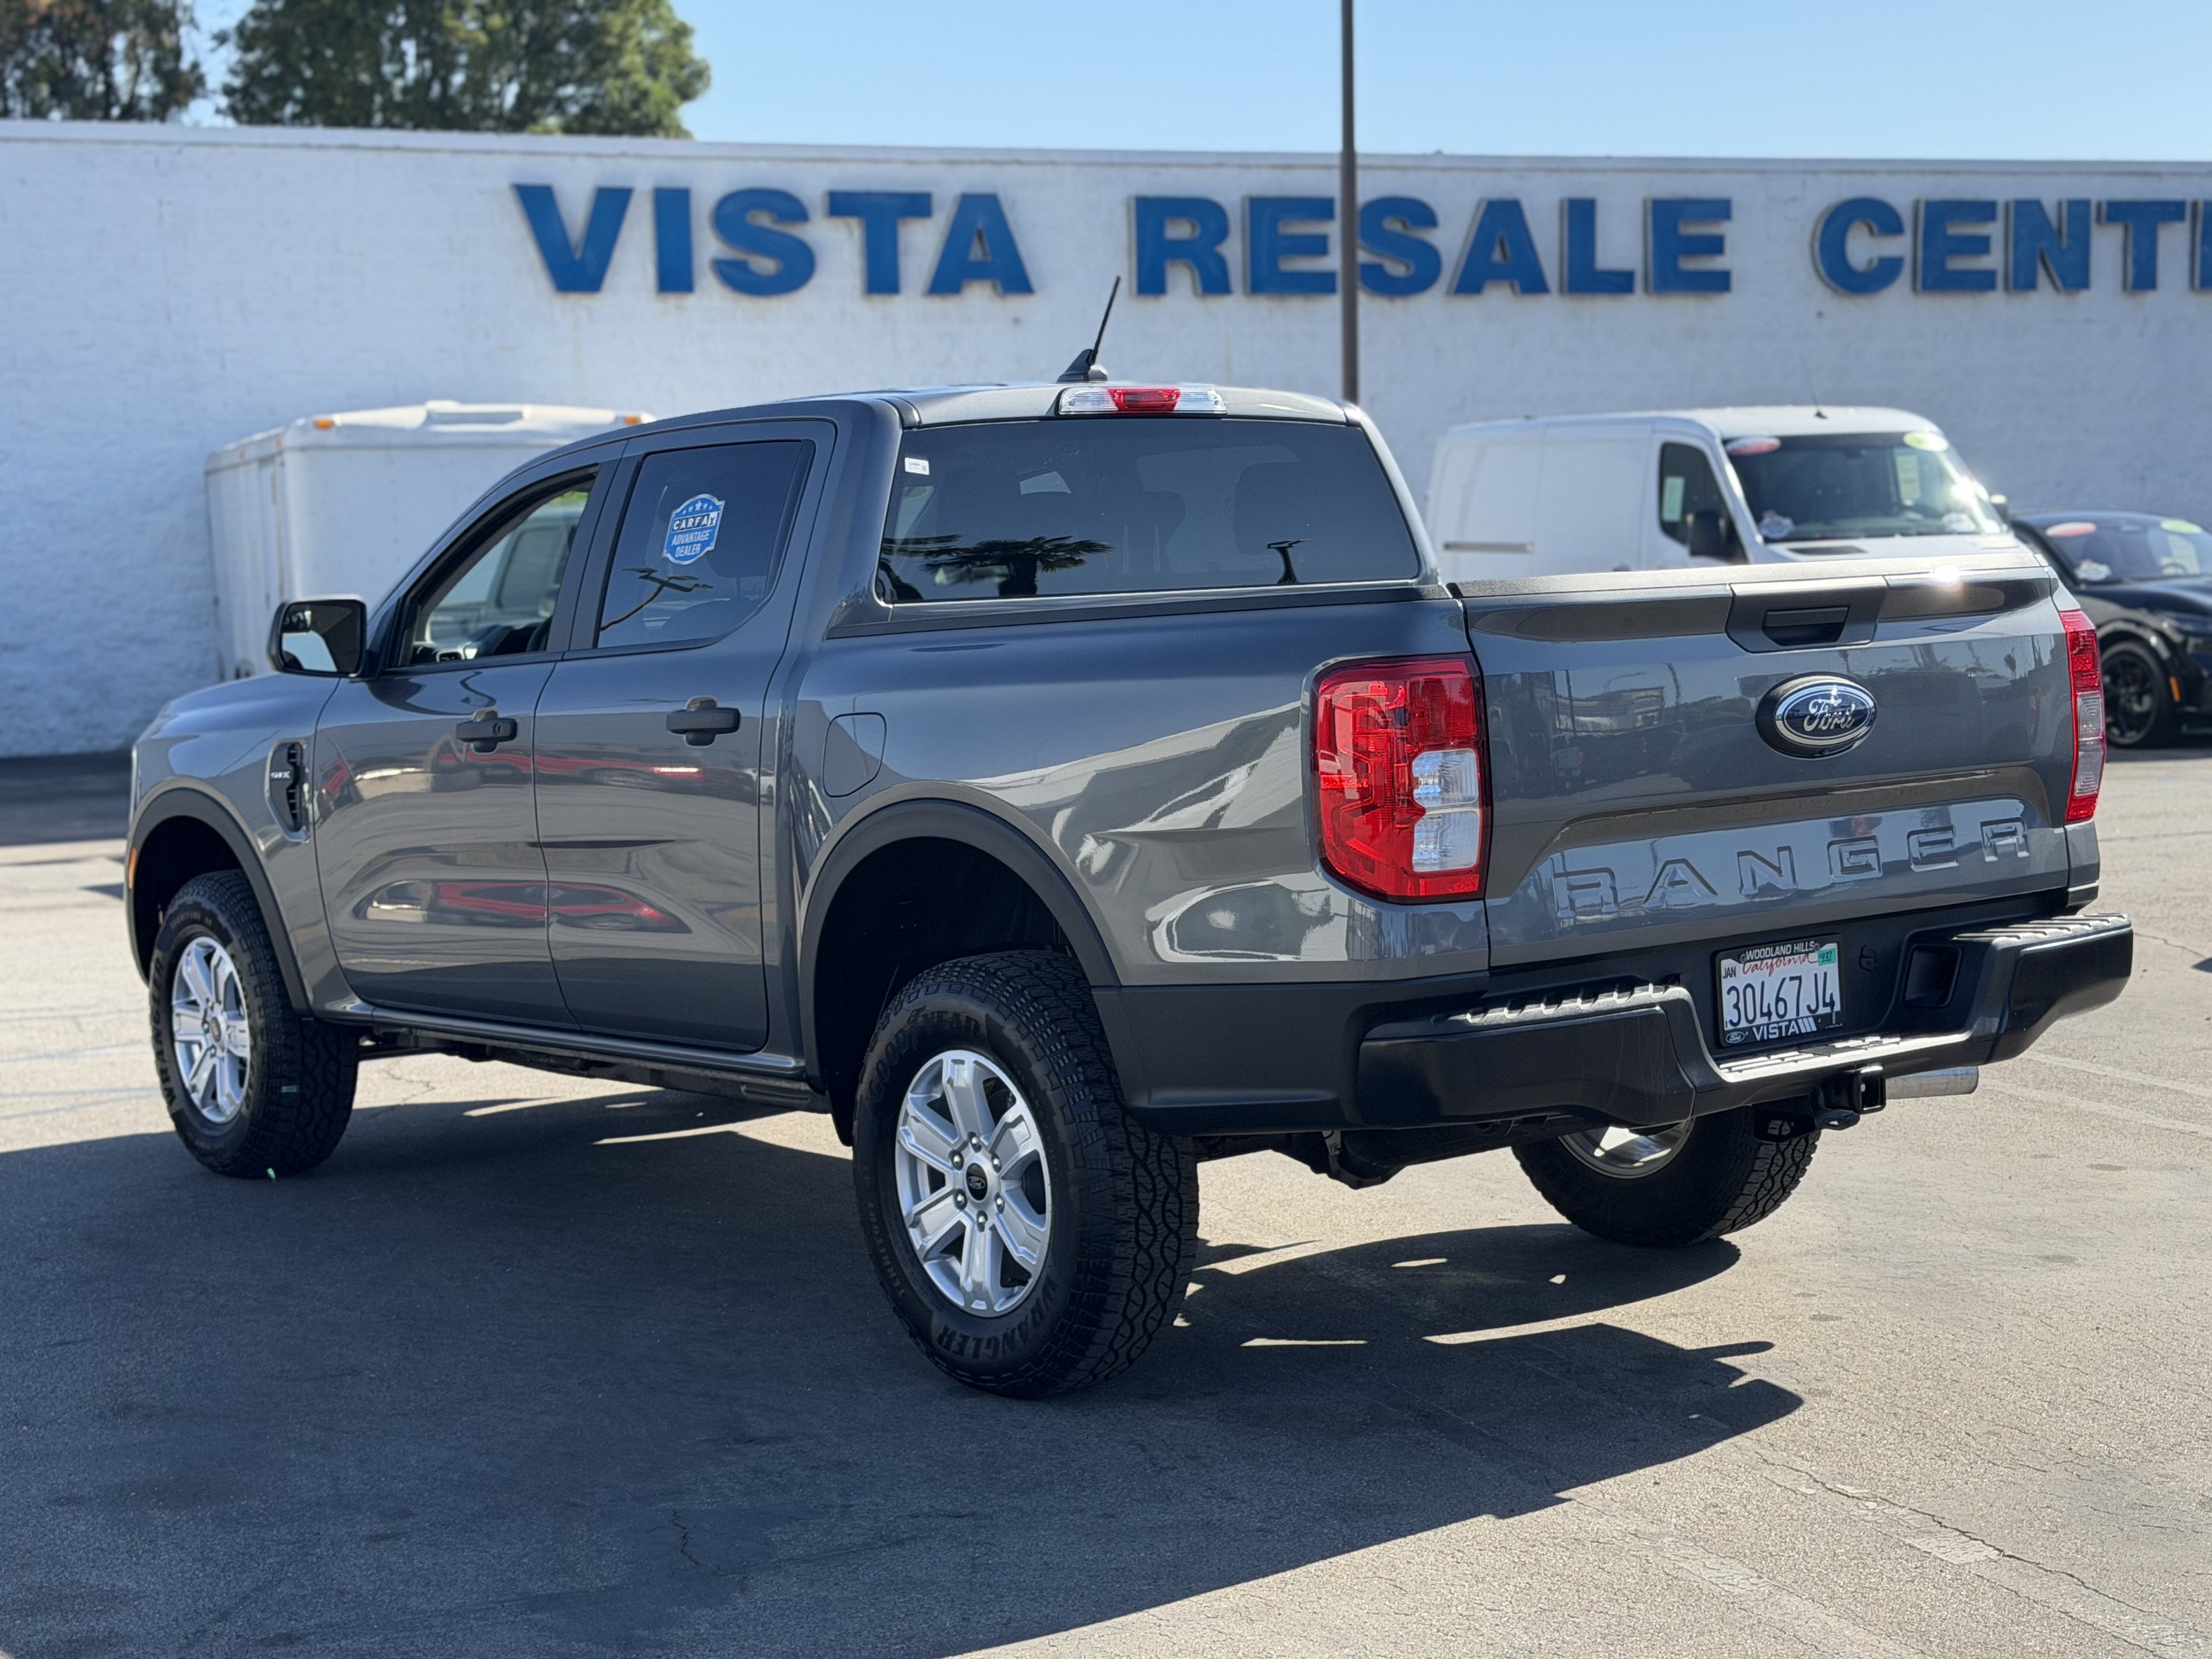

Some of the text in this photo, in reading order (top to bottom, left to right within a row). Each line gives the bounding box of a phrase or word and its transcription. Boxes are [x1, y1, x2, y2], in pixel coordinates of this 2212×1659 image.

[511, 183, 1035, 296] VISTA
[1127, 194, 1734, 297] RESALE
[673, 511, 718, 531] CARFAX
[672, 529, 713, 546] ADVANTAGE
[675, 543, 702, 558] DEALER
[1803, 698, 1855, 732] Ford
[1553, 816, 2030, 919] RANGER
[1746, 940, 1815, 961] WOODLAND HILLS
[1723, 966, 1736, 979] JAN
[1741, 953, 1818, 977] California
[1726, 971, 1836, 1028] 30467J4
[1752, 1020, 1800, 1041] VISTA
[936, 1276, 1059, 1360] WRANGLER
